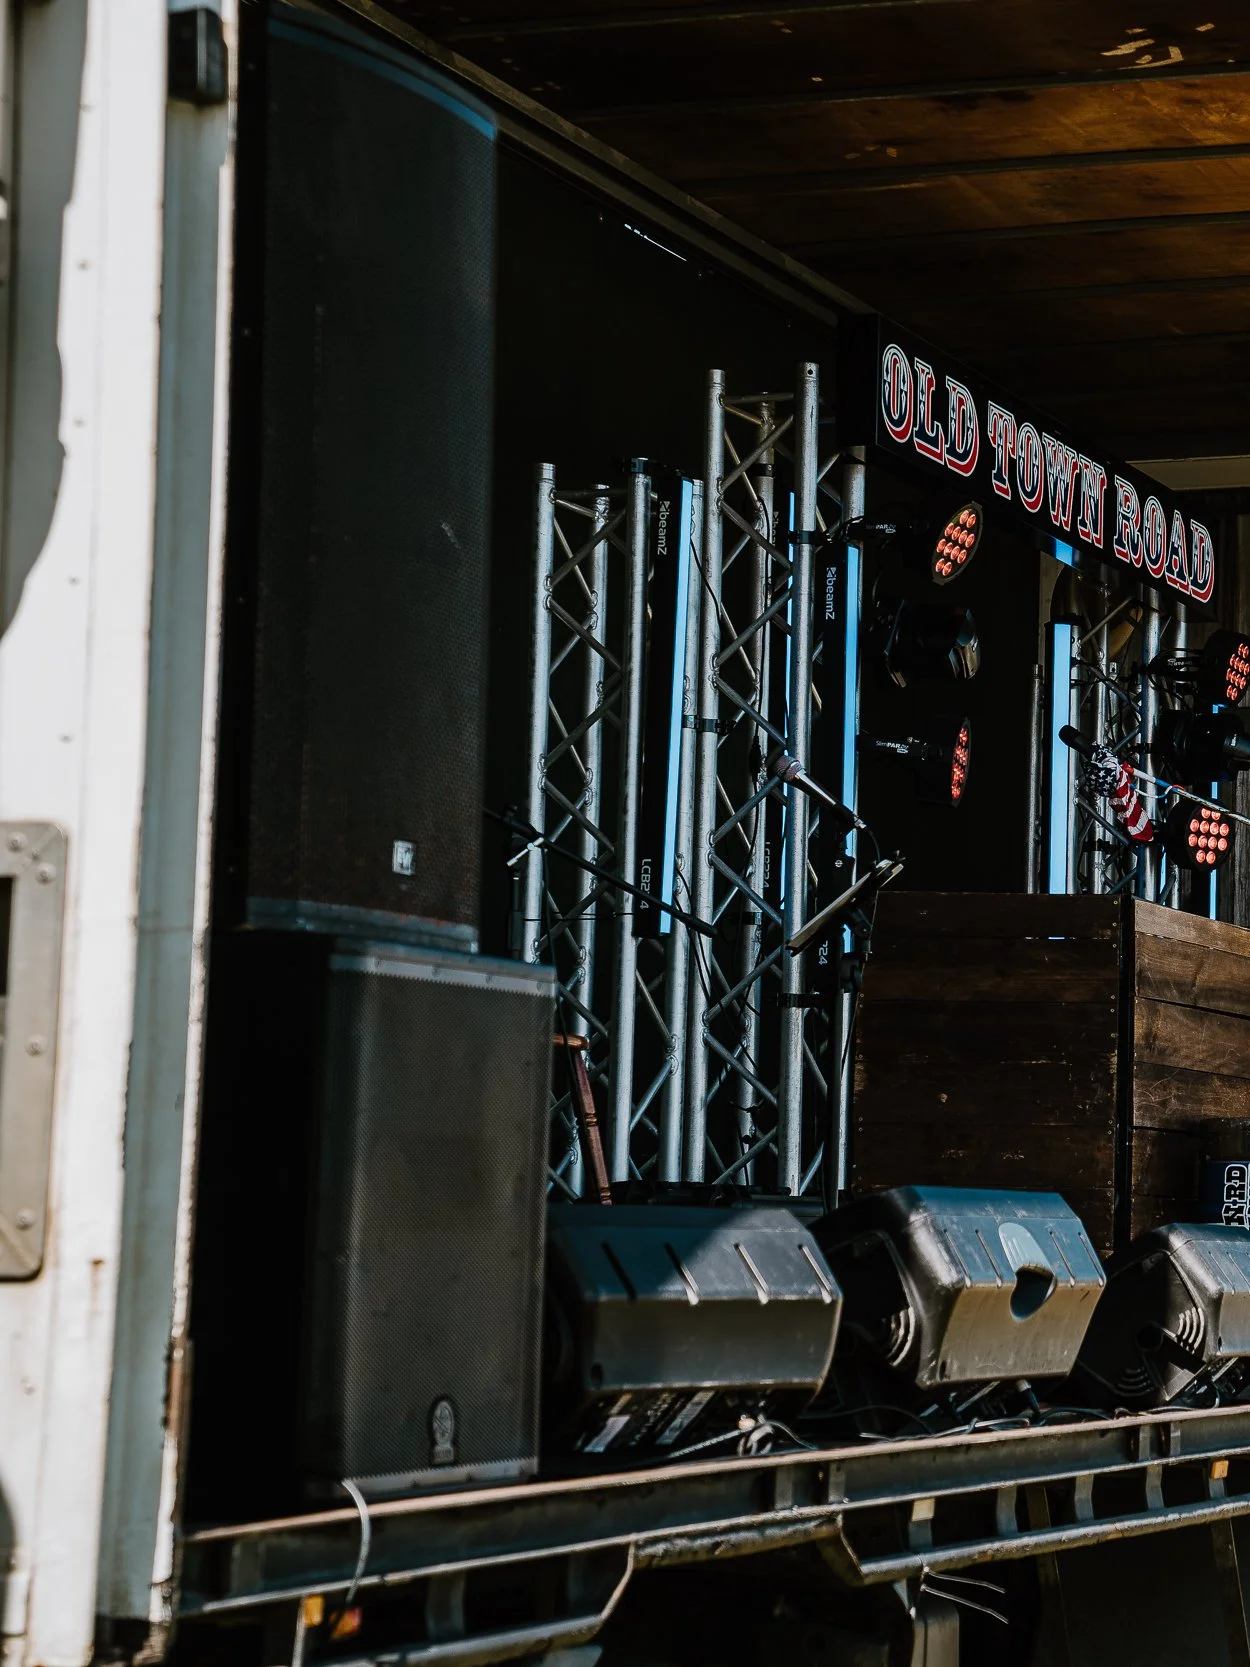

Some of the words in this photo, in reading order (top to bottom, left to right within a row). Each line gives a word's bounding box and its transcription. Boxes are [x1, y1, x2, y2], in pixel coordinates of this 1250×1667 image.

[881, 343, 980, 477] OLD
[987, 400, 1107, 549] TOWN
[1114, 474, 1215, 603] ROAD
[639, 858, 652, 910] LCB24
